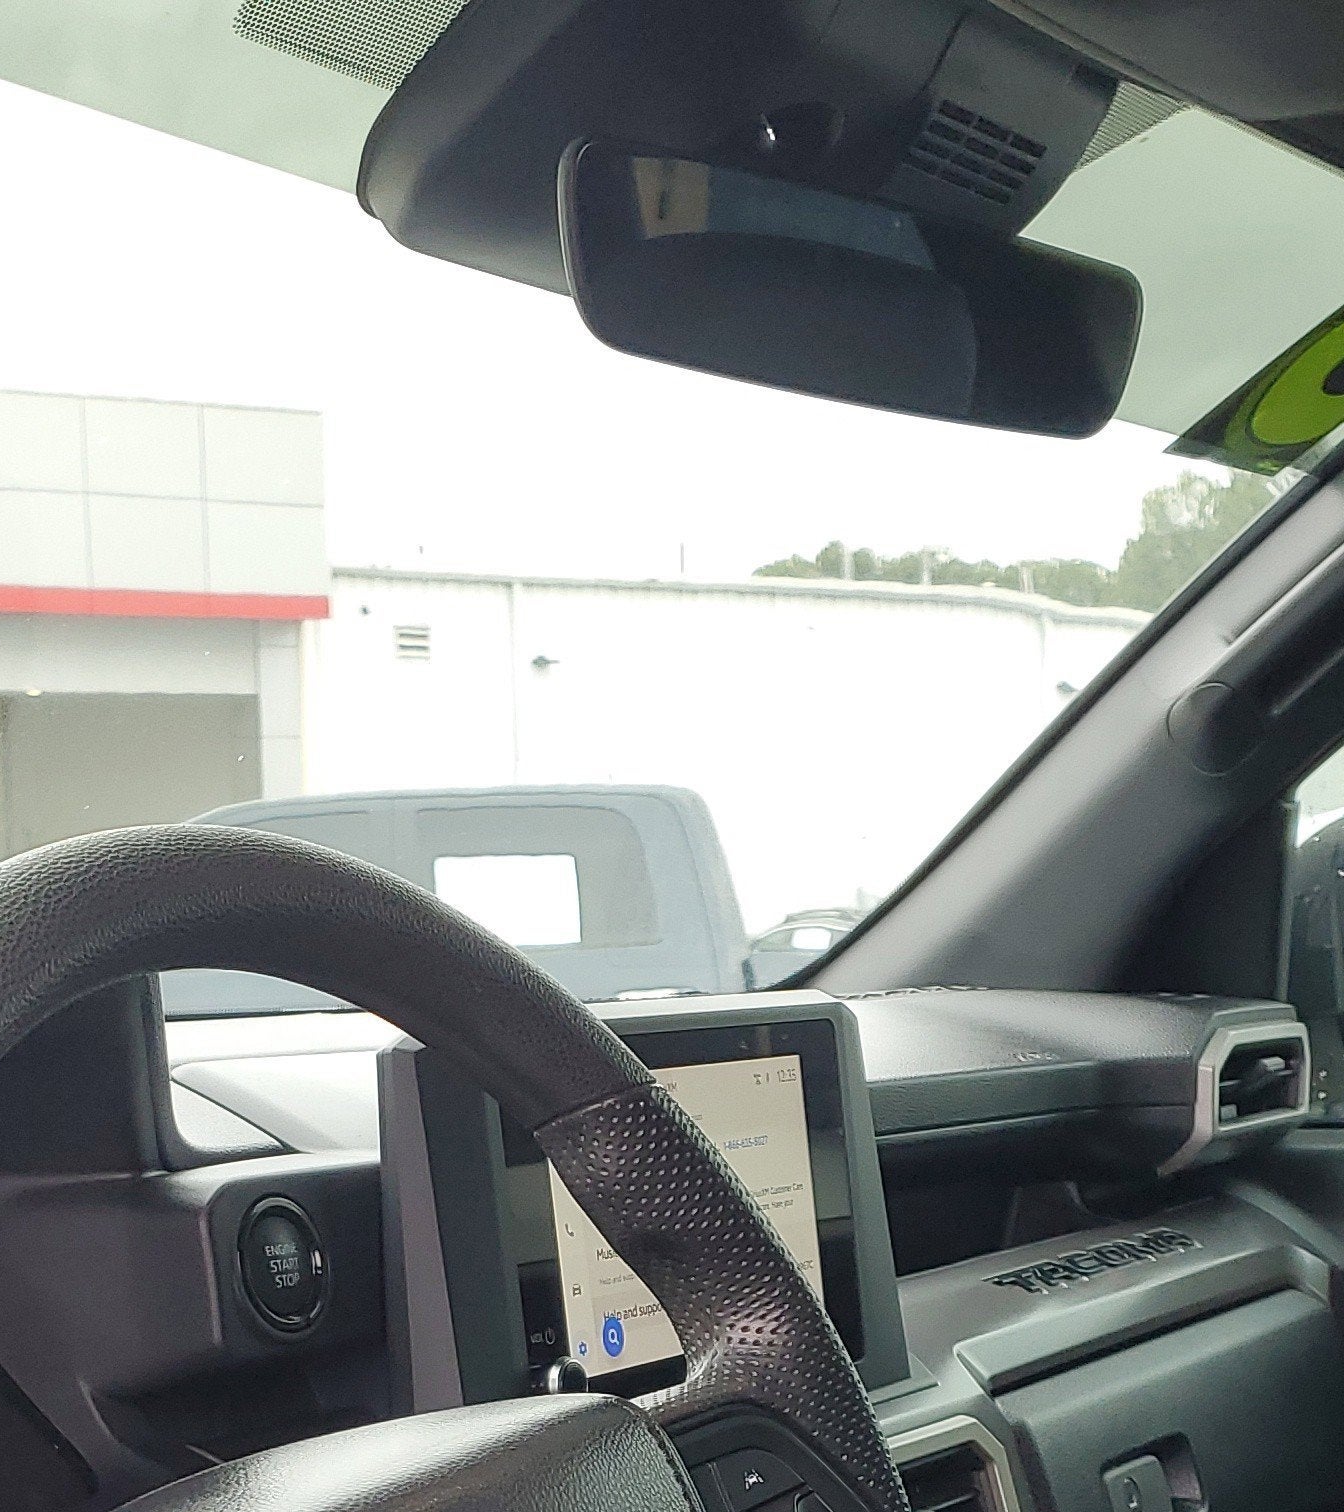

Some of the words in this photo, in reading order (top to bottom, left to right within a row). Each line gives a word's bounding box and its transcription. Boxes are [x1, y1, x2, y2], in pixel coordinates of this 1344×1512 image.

[269, 1256, 299, 1273] START
[981, 1227, 1203, 1294] TACOMA
[275, 1272, 300, 1289] STOP
[623, 1302, 638, 1319] and
